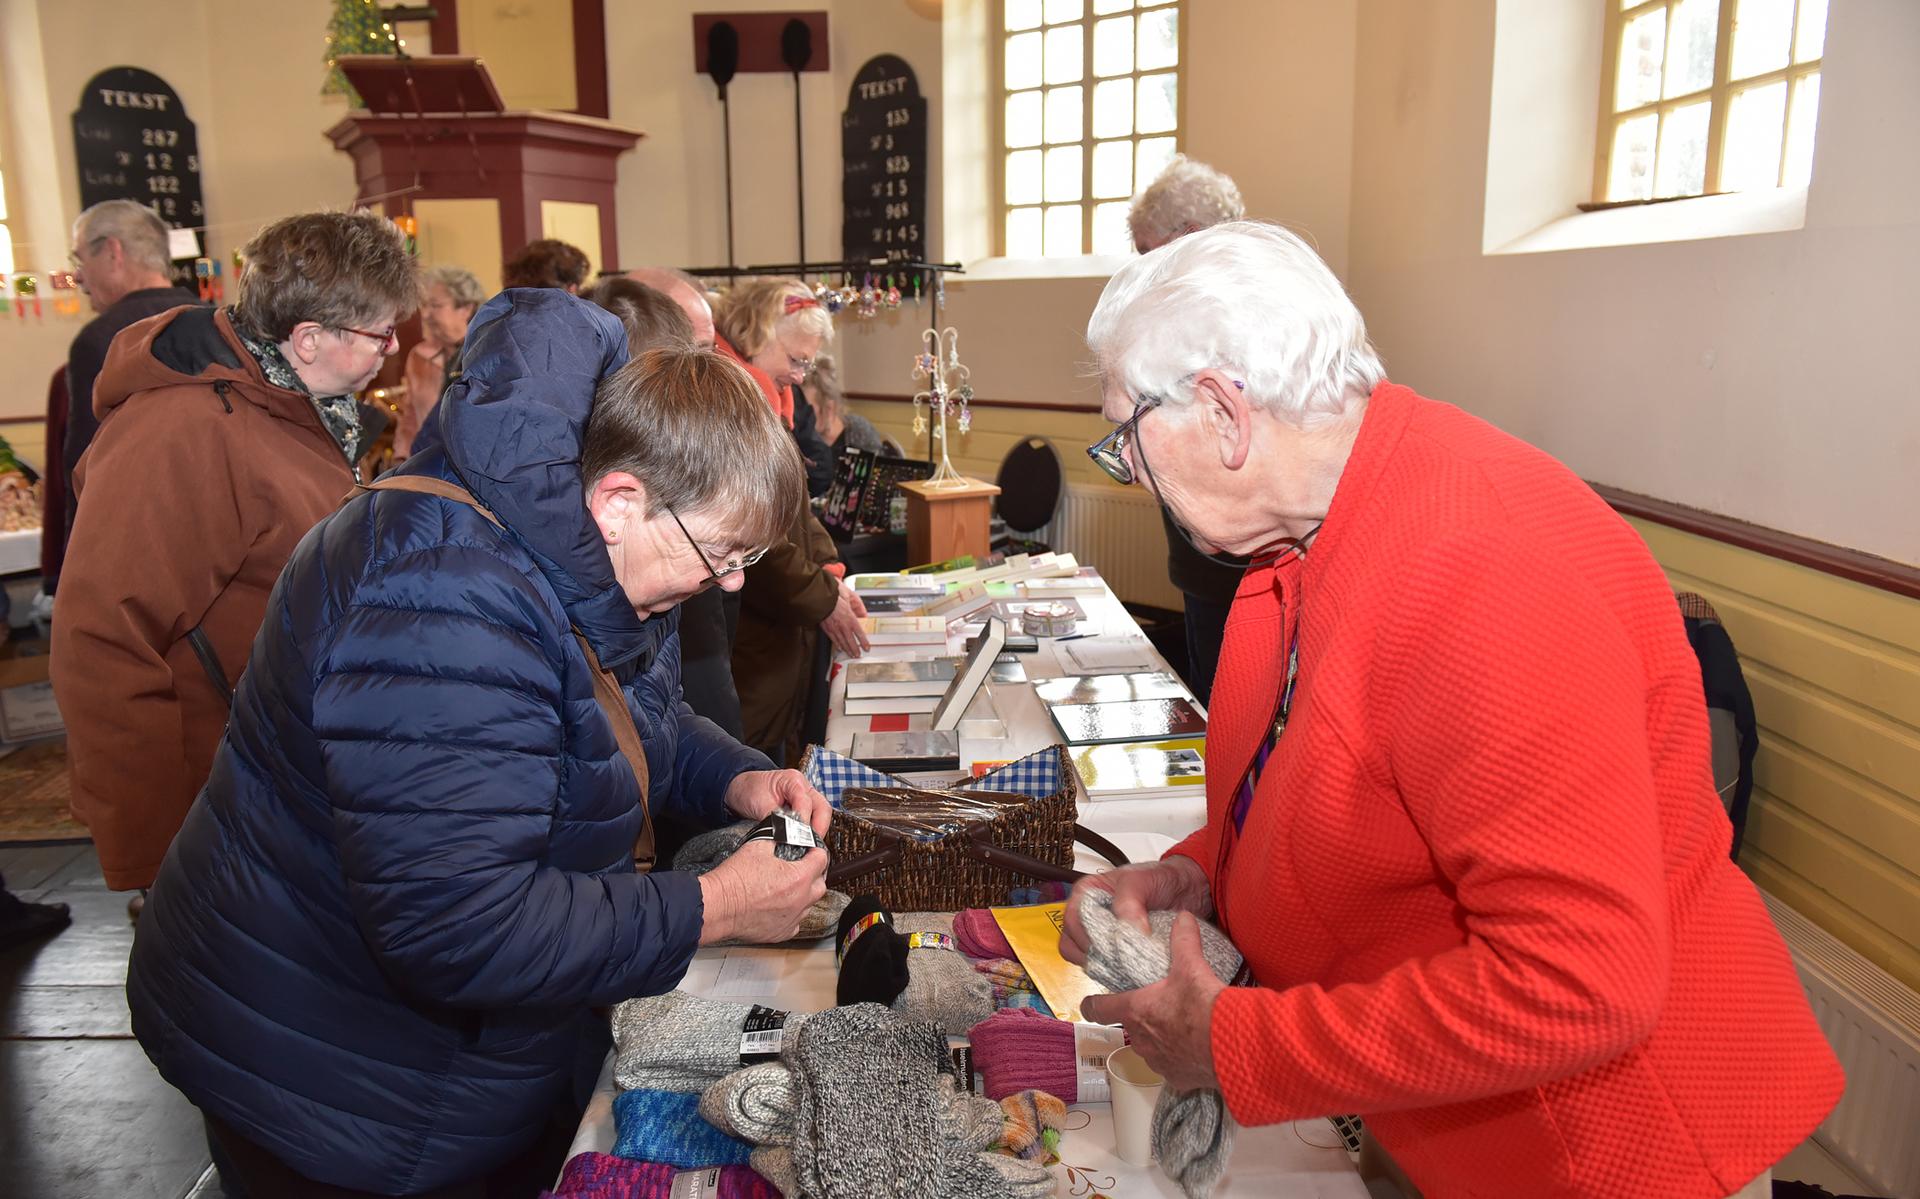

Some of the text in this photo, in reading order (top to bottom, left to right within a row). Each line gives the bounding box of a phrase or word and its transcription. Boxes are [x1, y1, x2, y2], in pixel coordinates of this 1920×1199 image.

[99, 88, 170, 111] TEKST
[859, 77, 908, 100] TEKST
[146, 175, 180, 193] 122
[688, 1171, 701, 1199] MARAT
